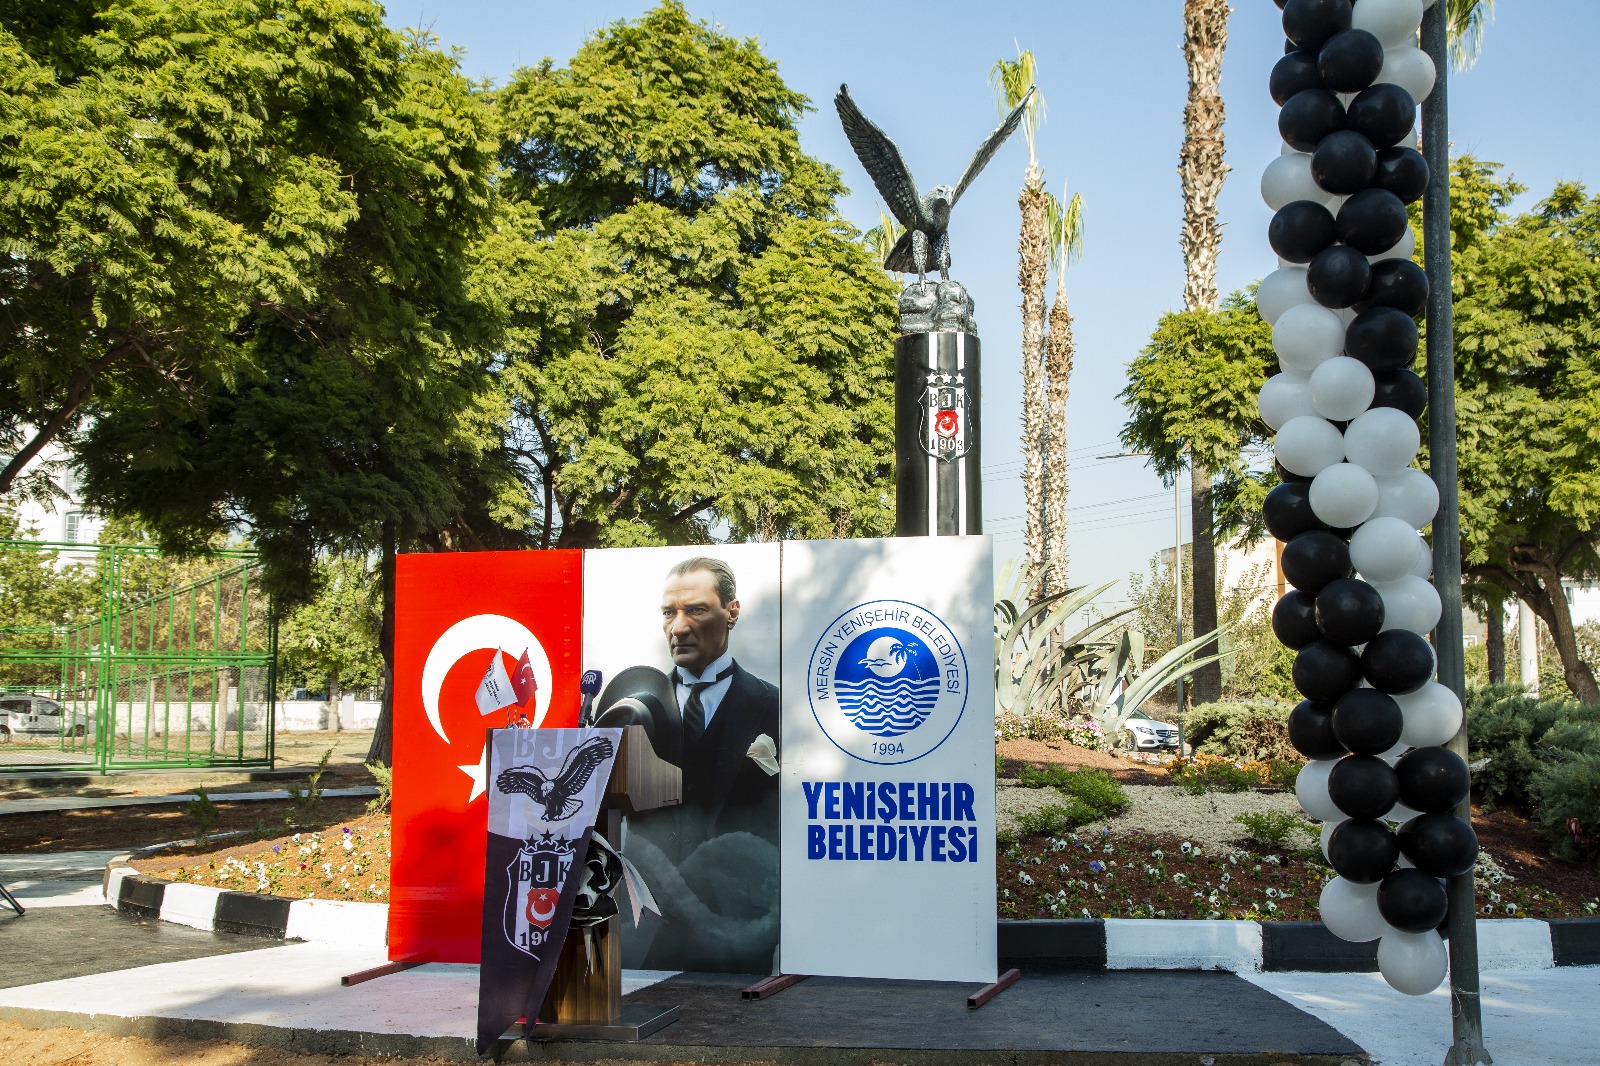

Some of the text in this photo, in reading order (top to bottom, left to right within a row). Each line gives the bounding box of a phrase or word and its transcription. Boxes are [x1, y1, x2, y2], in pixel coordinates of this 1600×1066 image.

[929, 393, 965, 408] BJK
[930, 438, 965, 452] 1903
[816, 607, 962, 701] MERSİN YENİŞEHİR BELEDİYESİ
[871, 741, 905, 756] 1994
[802, 781, 976, 824] YENİŞEHİR
[807, 824, 978, 863] BELEDİYESİ
